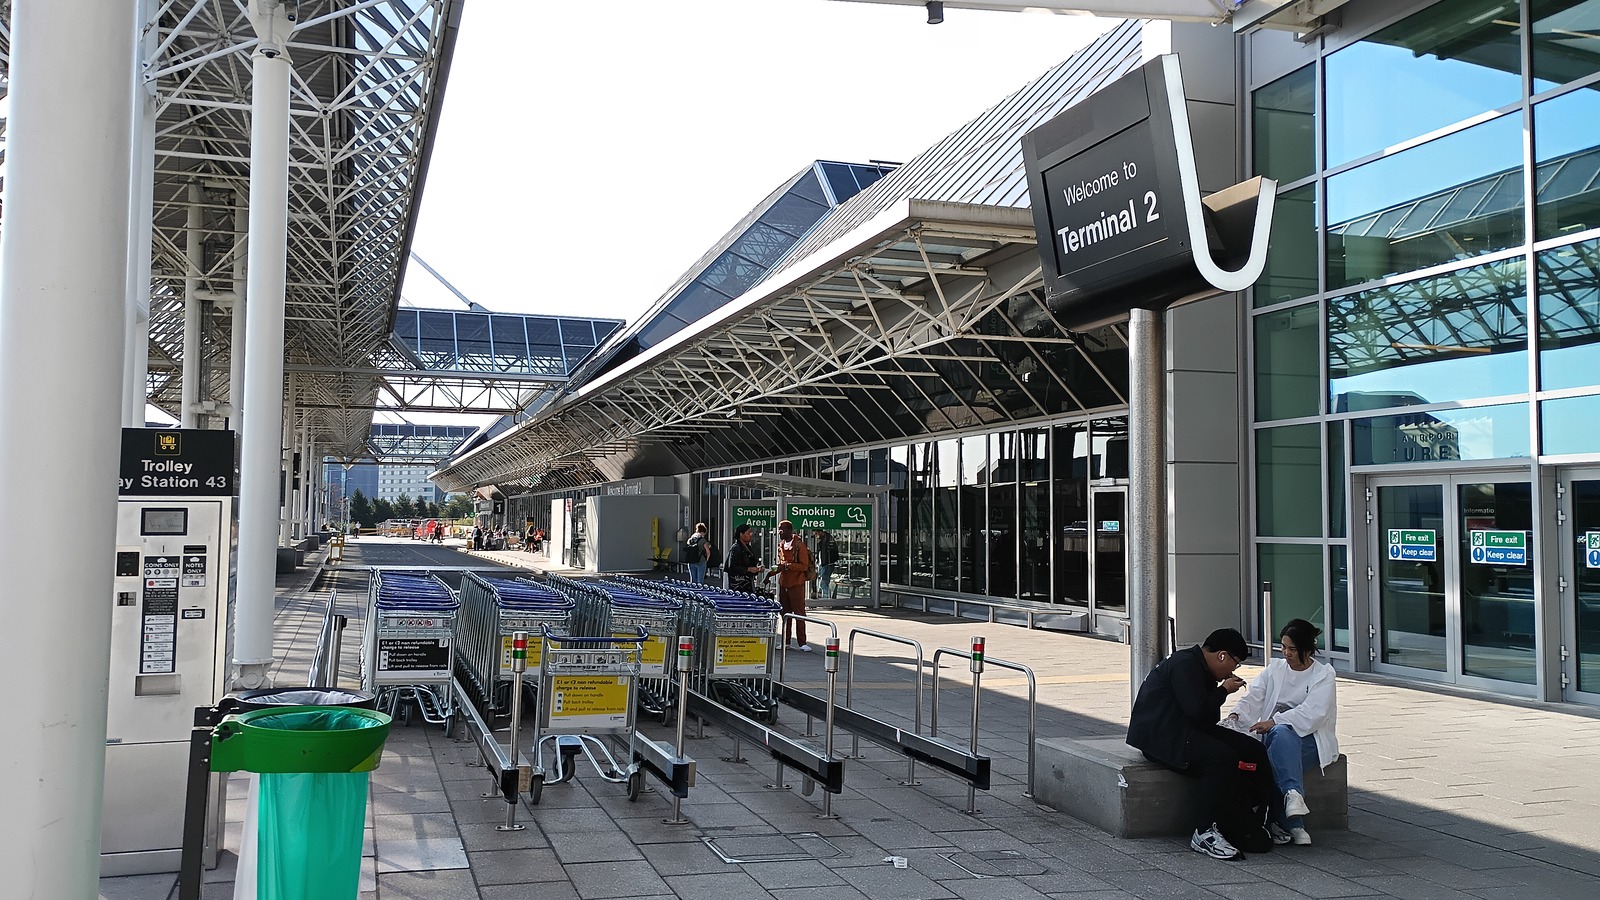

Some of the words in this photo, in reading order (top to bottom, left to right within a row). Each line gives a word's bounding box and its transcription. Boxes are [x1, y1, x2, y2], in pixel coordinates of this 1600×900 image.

[1063, 170, 1119, 206] Welcome
[1123, 161, 1137, 180] to
[1057, 199, 1138, 255] Terminal
[1144, 190, 1160, 223] 2
[1403, 432, 1455, 443] AIRPOR
[141, 460, 193, 474] Trolley
[119, 478, 133, 489] ay
[141, 475, 199, 488] Station
[205, 476, 226, 488] 43
[737, 507, 776, 517] Smoking
[791, 506, 835, 517] Smoking
[801, 519, 825, 528] Area
[1418, 534, 1429, 542] exit
[1490, 535, 1503, 543] Fire
[1505, 536, 1518, 544] exit
[1402, 548, 1418, 557] Keep
[1419, 548, 1434, 556] clear
[1487, 550, 1504, 560] Keep
[1506, 551, 1523, 559] clear
